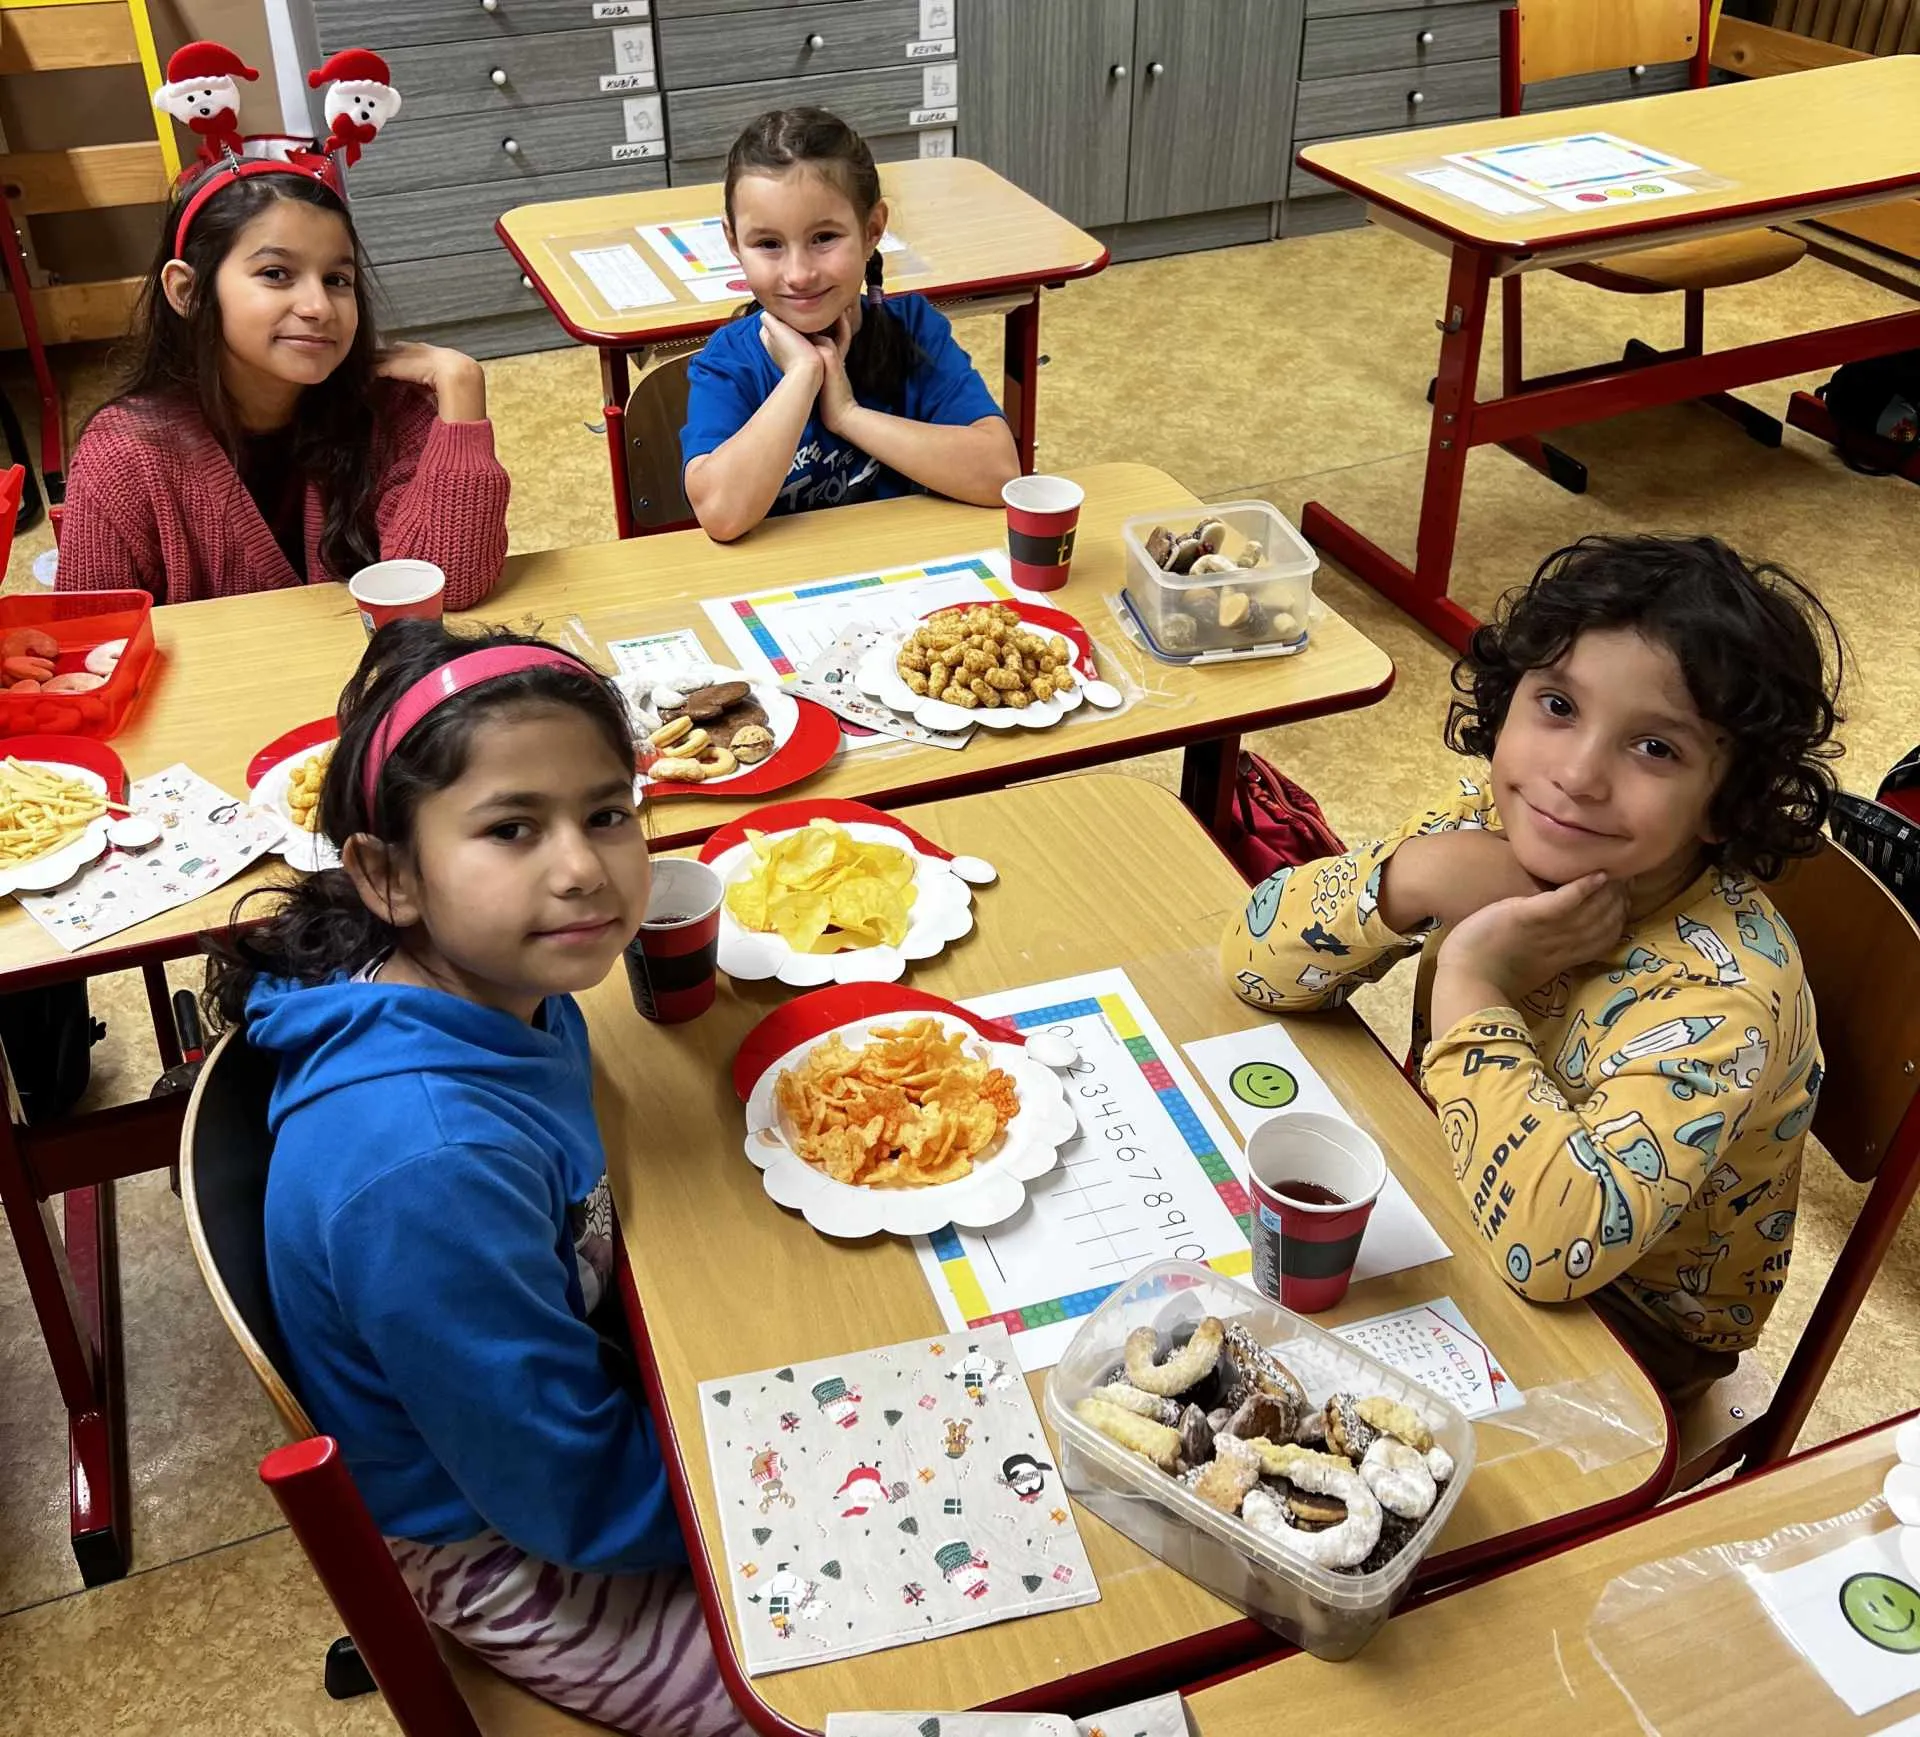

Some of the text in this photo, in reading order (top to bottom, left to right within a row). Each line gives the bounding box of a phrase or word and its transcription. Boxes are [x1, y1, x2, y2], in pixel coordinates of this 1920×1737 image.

[1066, 1062, 1096, 1080] 2
[1080, 1083, 1108, 1098] 3
[1095, 1101, 1122, 1118] 4
[1104, 1123, 1136, 1141] 5
[1116, 1147, 1147, 1161] 6
[1474, 1113, 1541, 1215] RIDDLE
[1128, 1167, 1162, 1180] 7
[1143, 1191, 1173, 1208] 8
[1158, 1209, 1187, 1229] 9
[1481, 1180, 1516, 1242] IME
[1428, 1326, 1482, 1391] ABECEDA
